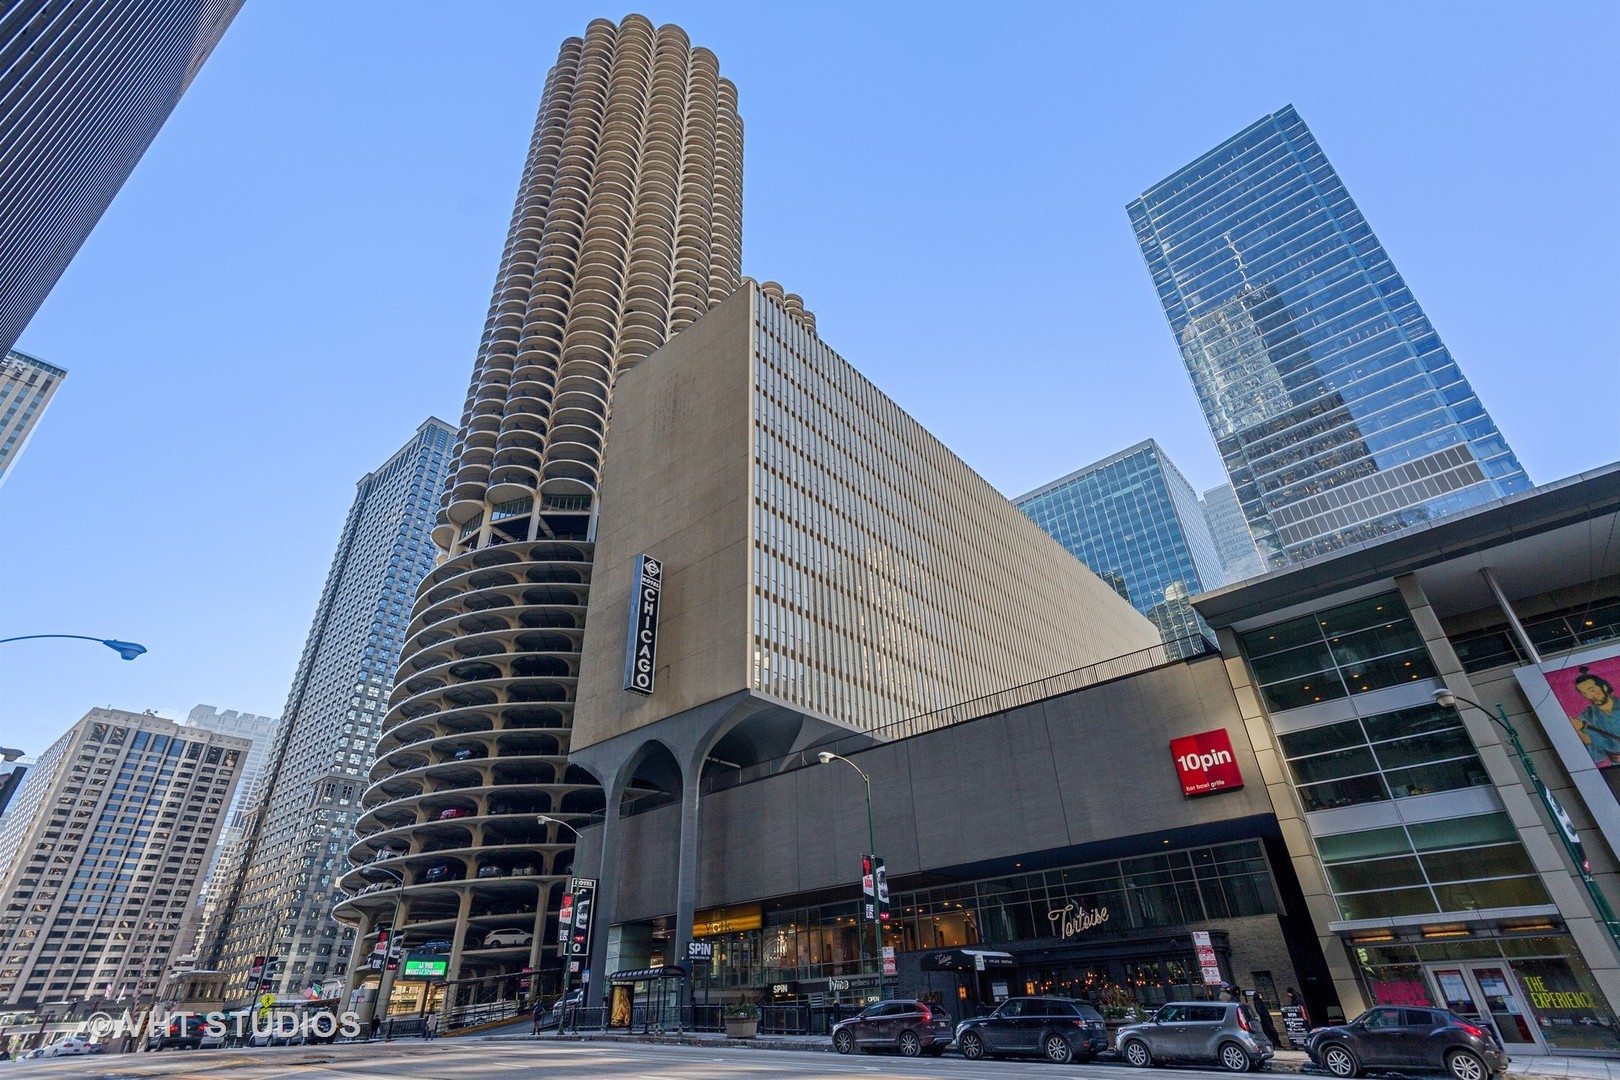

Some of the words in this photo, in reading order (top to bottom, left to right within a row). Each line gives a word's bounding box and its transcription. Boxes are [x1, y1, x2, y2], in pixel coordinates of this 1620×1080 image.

[642, 577, 660, 589] HOTEL
[636, 589, 656, 688] CHICAGO
[1177, 749, 1232, 772] 10pin
[1196, 782, 1210, 790] bowl
[1210, 780, 1225, 788] grille
[1047, 904, 1110, 940] Tortoise
[1523, 976, 1549, 992] THE
[867, 995, 880, 1003] OPEN
[1530, 991, 1599, 1009] EXPERIENCE
